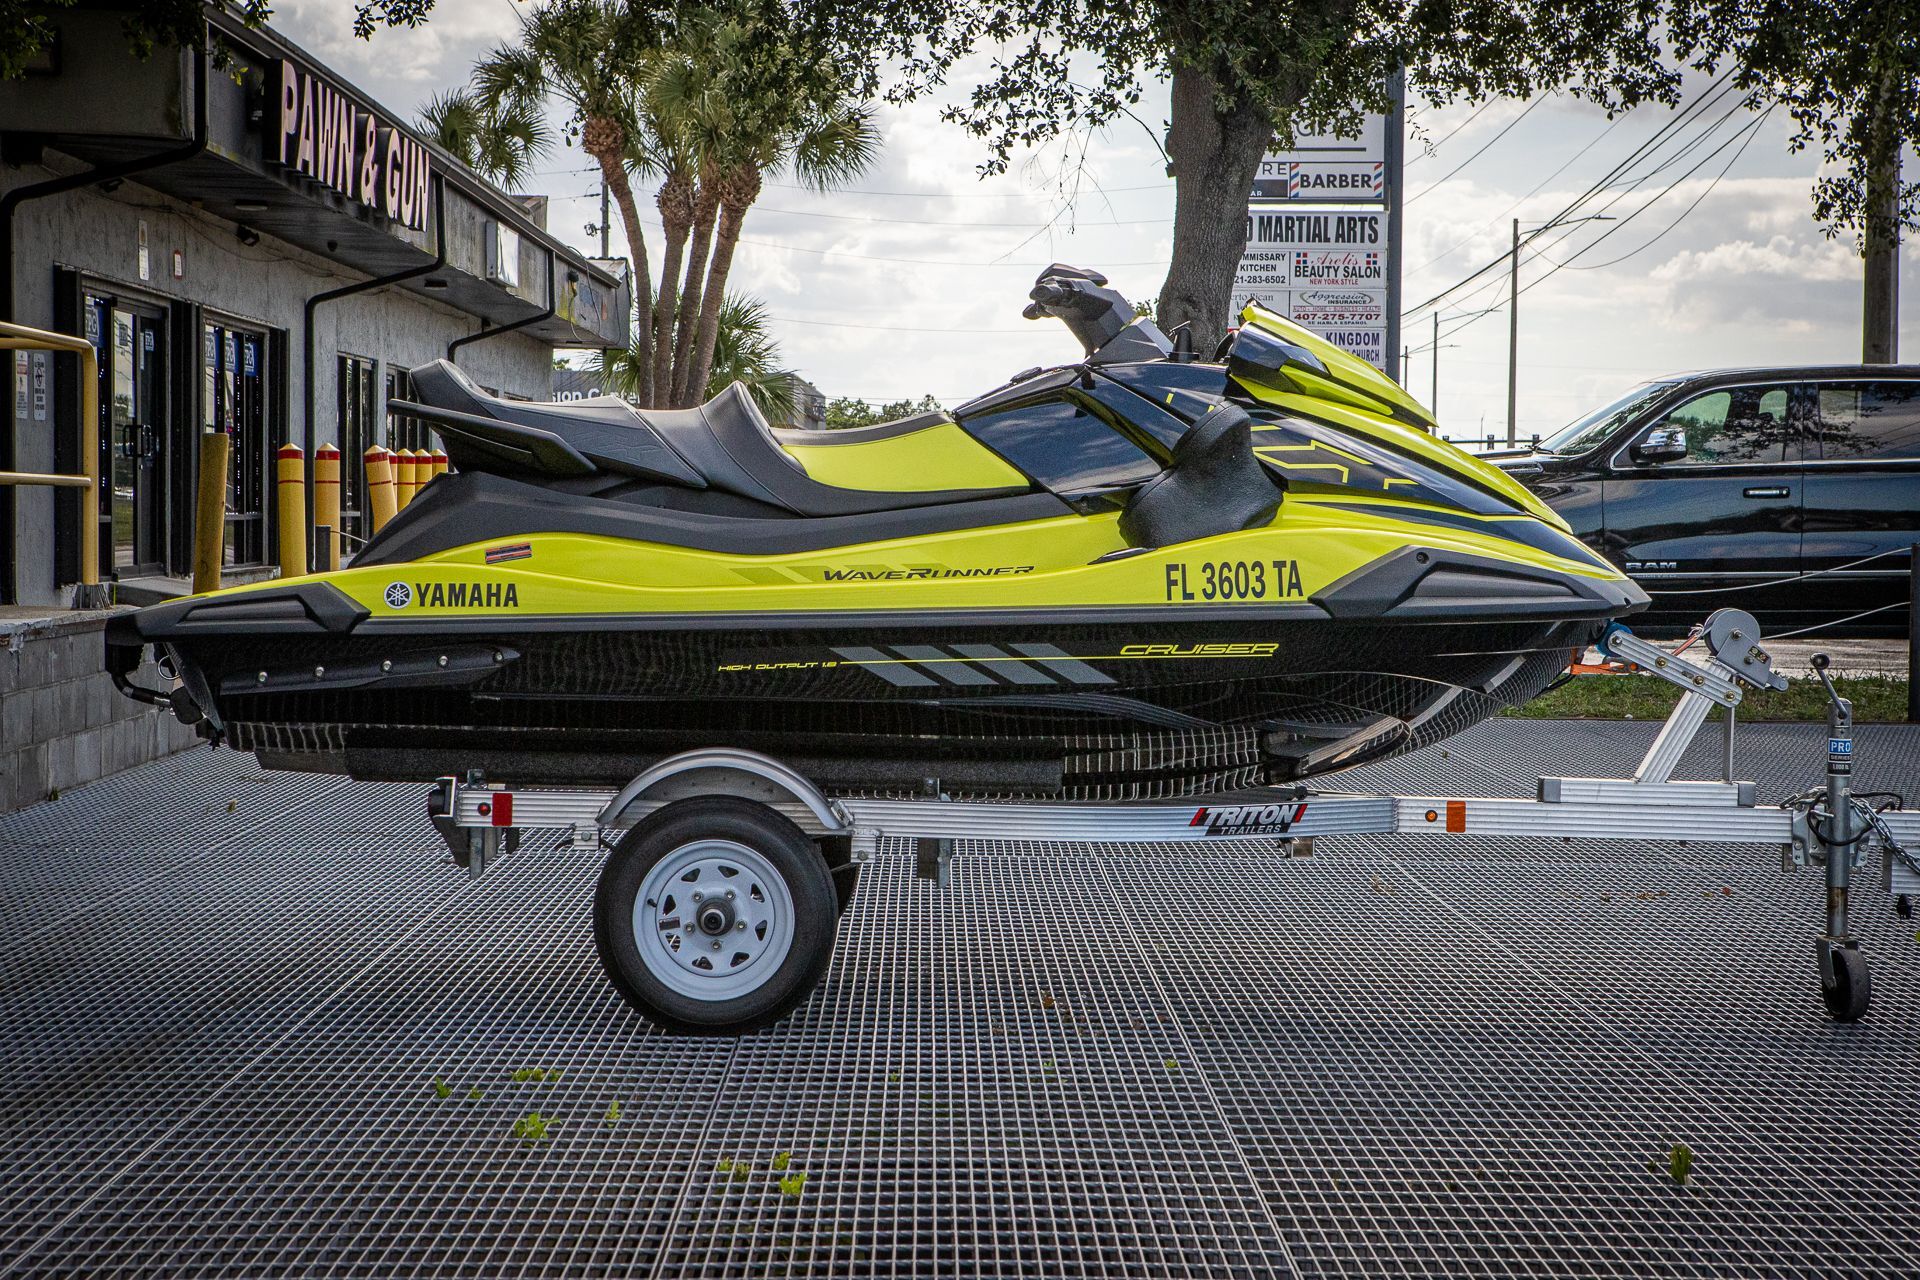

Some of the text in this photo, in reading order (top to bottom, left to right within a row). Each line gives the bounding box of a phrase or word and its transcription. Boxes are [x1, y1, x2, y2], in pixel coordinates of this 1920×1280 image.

[280, 59, 430, 232] PAWN & GUN
[1300, 174, 1373, 189] BARBER
[1258, 215, 1331, 243] MARTIAL
[1334, 215, 1379, 244] ARTS
[1295, 265, 1381, 278] BEAUTY SALON
[1295, 313, 1381, 321] 407-275-7707
[1326, 332, 1380, 346] KINGDOM
[1166, 560, 1304, 600] FL 3603 TA
[415, 583, 519, 607] YAMAHA
[1120, 643, 1280, 655] CRUISER
[755, 662, 819, 670] OUTPUT
[1831, 741, 1851, 752] PRO
[1204, 804, 1299, 826] TRITON
[1221, 825, 1281, 835] TRAILERS
